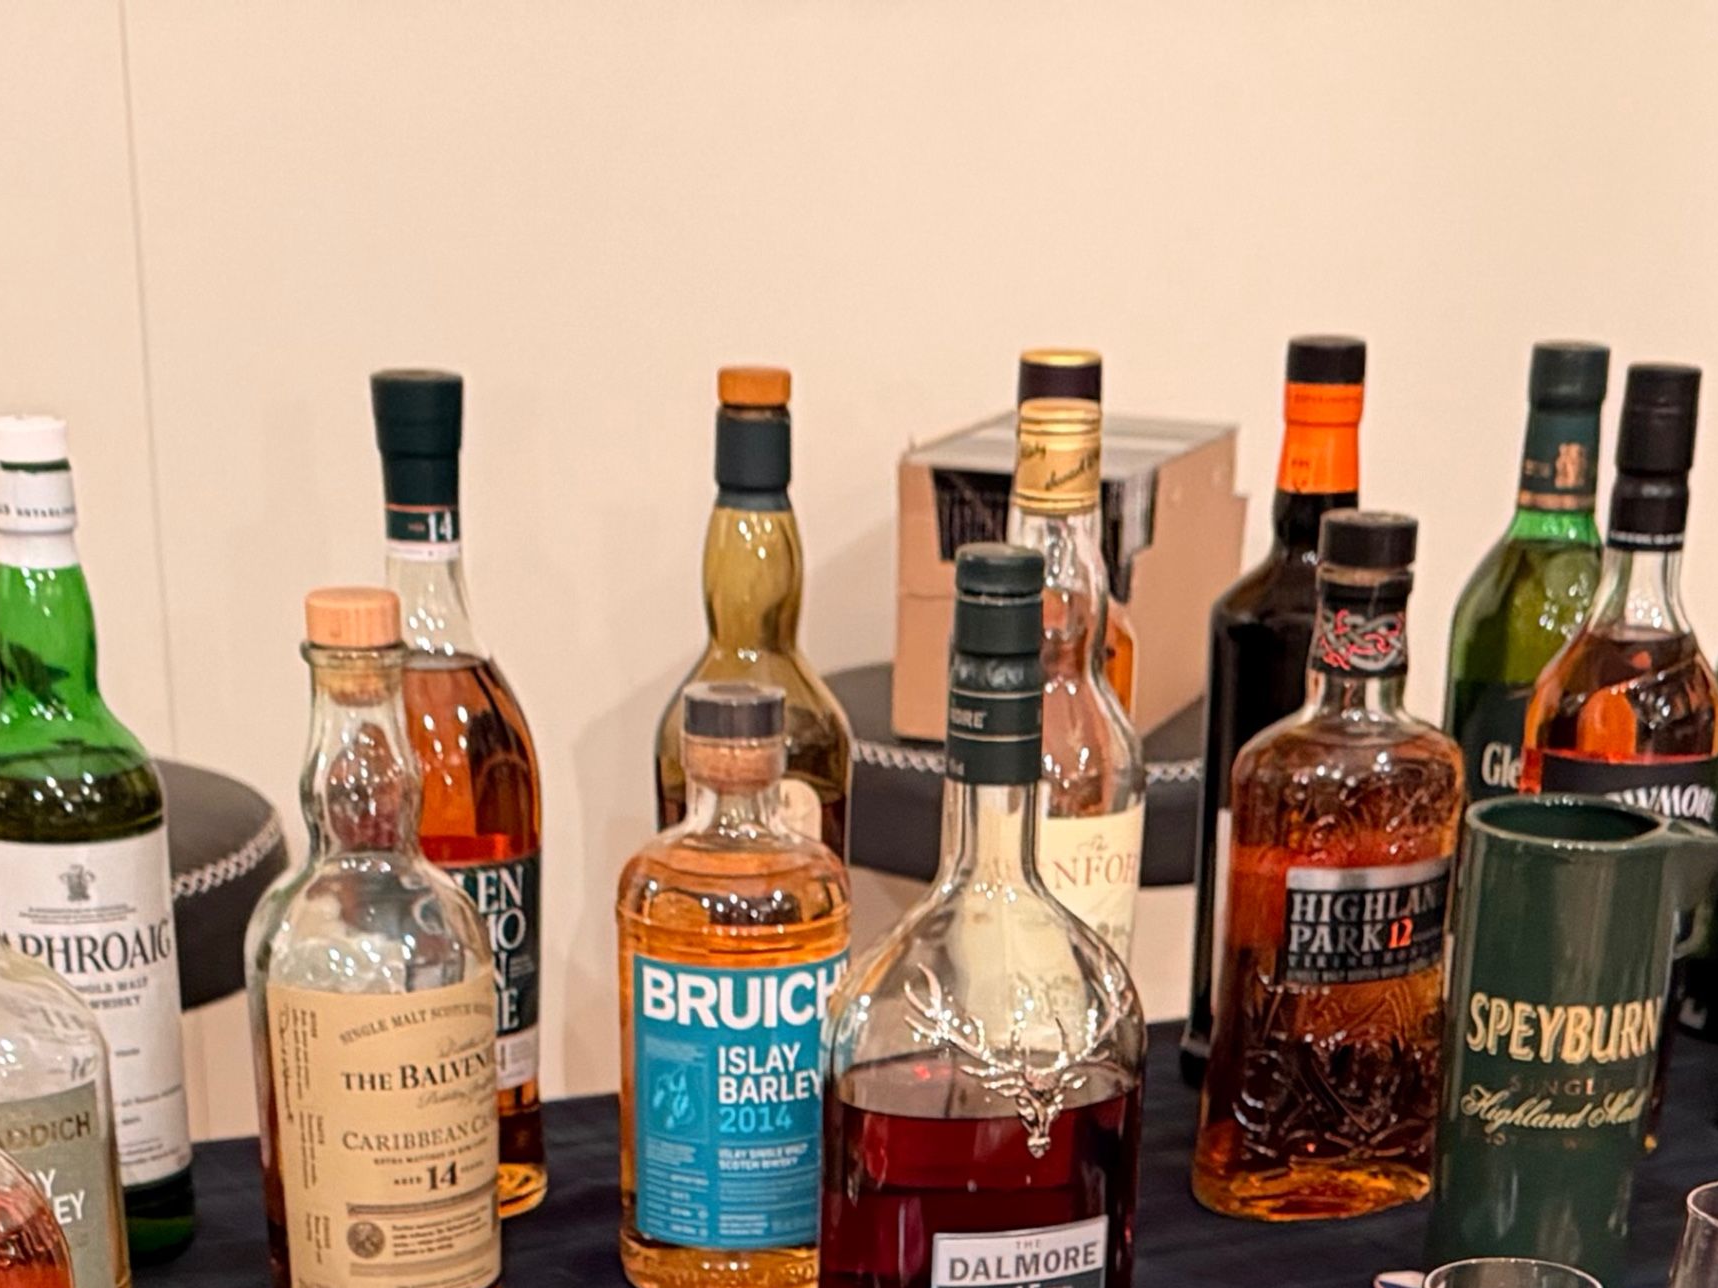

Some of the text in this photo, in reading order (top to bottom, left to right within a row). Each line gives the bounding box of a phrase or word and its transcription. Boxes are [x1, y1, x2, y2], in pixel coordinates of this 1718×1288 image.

[427, 511, 453, 542] 14
[1289, 916, 1413, 955] PARK 12
[390, 1009, 427, 1029] MALT
[1466, 991, 1663, 1064] SPEYBURN
[718, 1041, 801, 1076] ISLAY
[342, 1072, 392, 1091] THE
[718, 1068, 823, 1105] BARLEY
[719, 1104, 793, 1134] 2014
[1461, 1083, 1593, 1134] Highland
[342, 1121, 469, 1151] CARIBBEAN
[426, 1161, 459, 1190] 14
[1015, 1239, 1042, 1250] THE
[949, 1241, 1097, 1282] DALMORE
